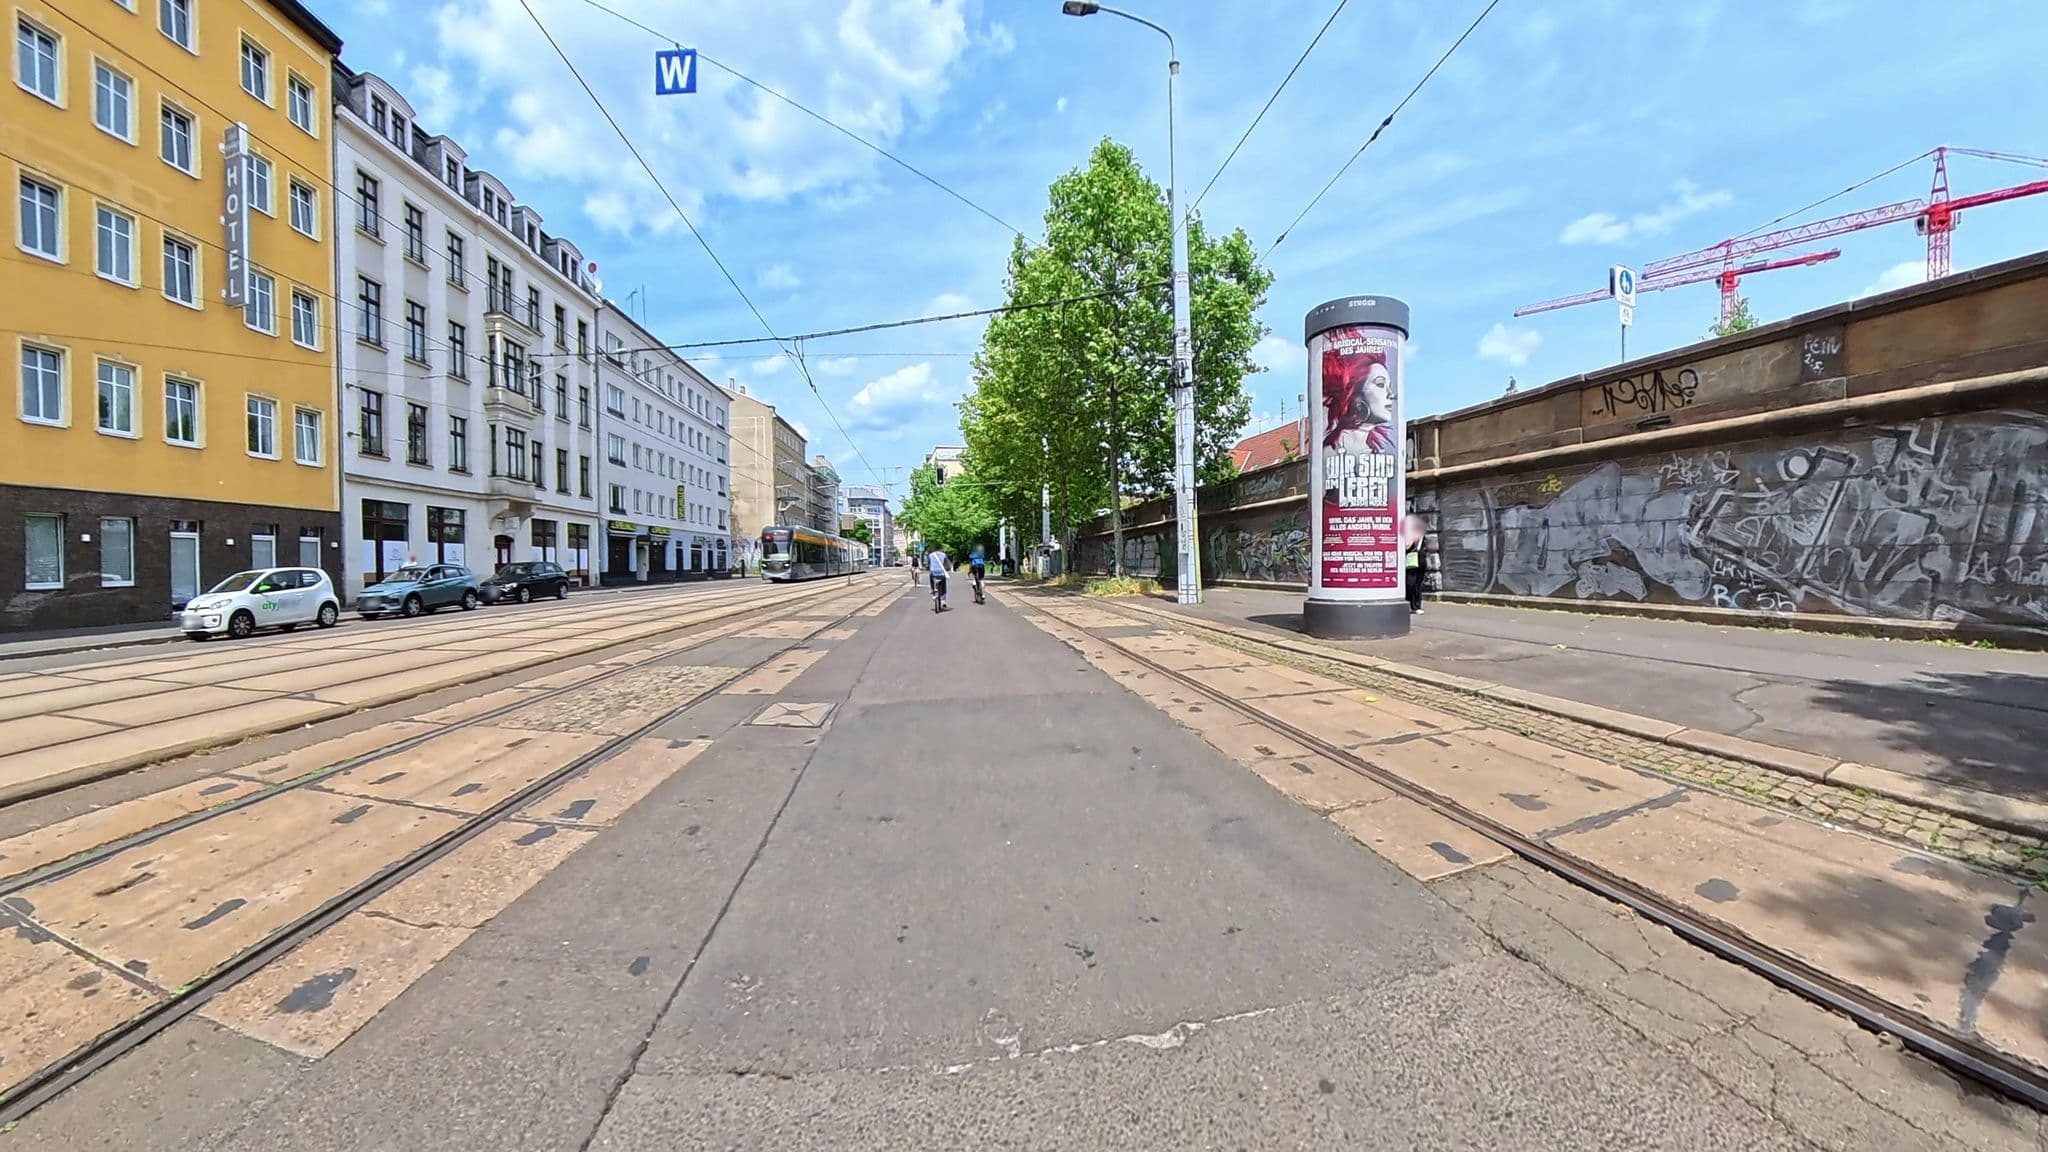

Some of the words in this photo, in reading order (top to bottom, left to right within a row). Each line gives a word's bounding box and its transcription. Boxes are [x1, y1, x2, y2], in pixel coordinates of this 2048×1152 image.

[660, 55, 692, 89] W
[226, 165, 240, 298] HOTEL
[1340, 346, 1354, 356] DES
[1326, 450, 1356, 478] WIR
[1358, 453, 1394, 478] SIND
[1339, 477, 1388, 507] LEBEN
[1343, 516, 1357, 524] DAS
